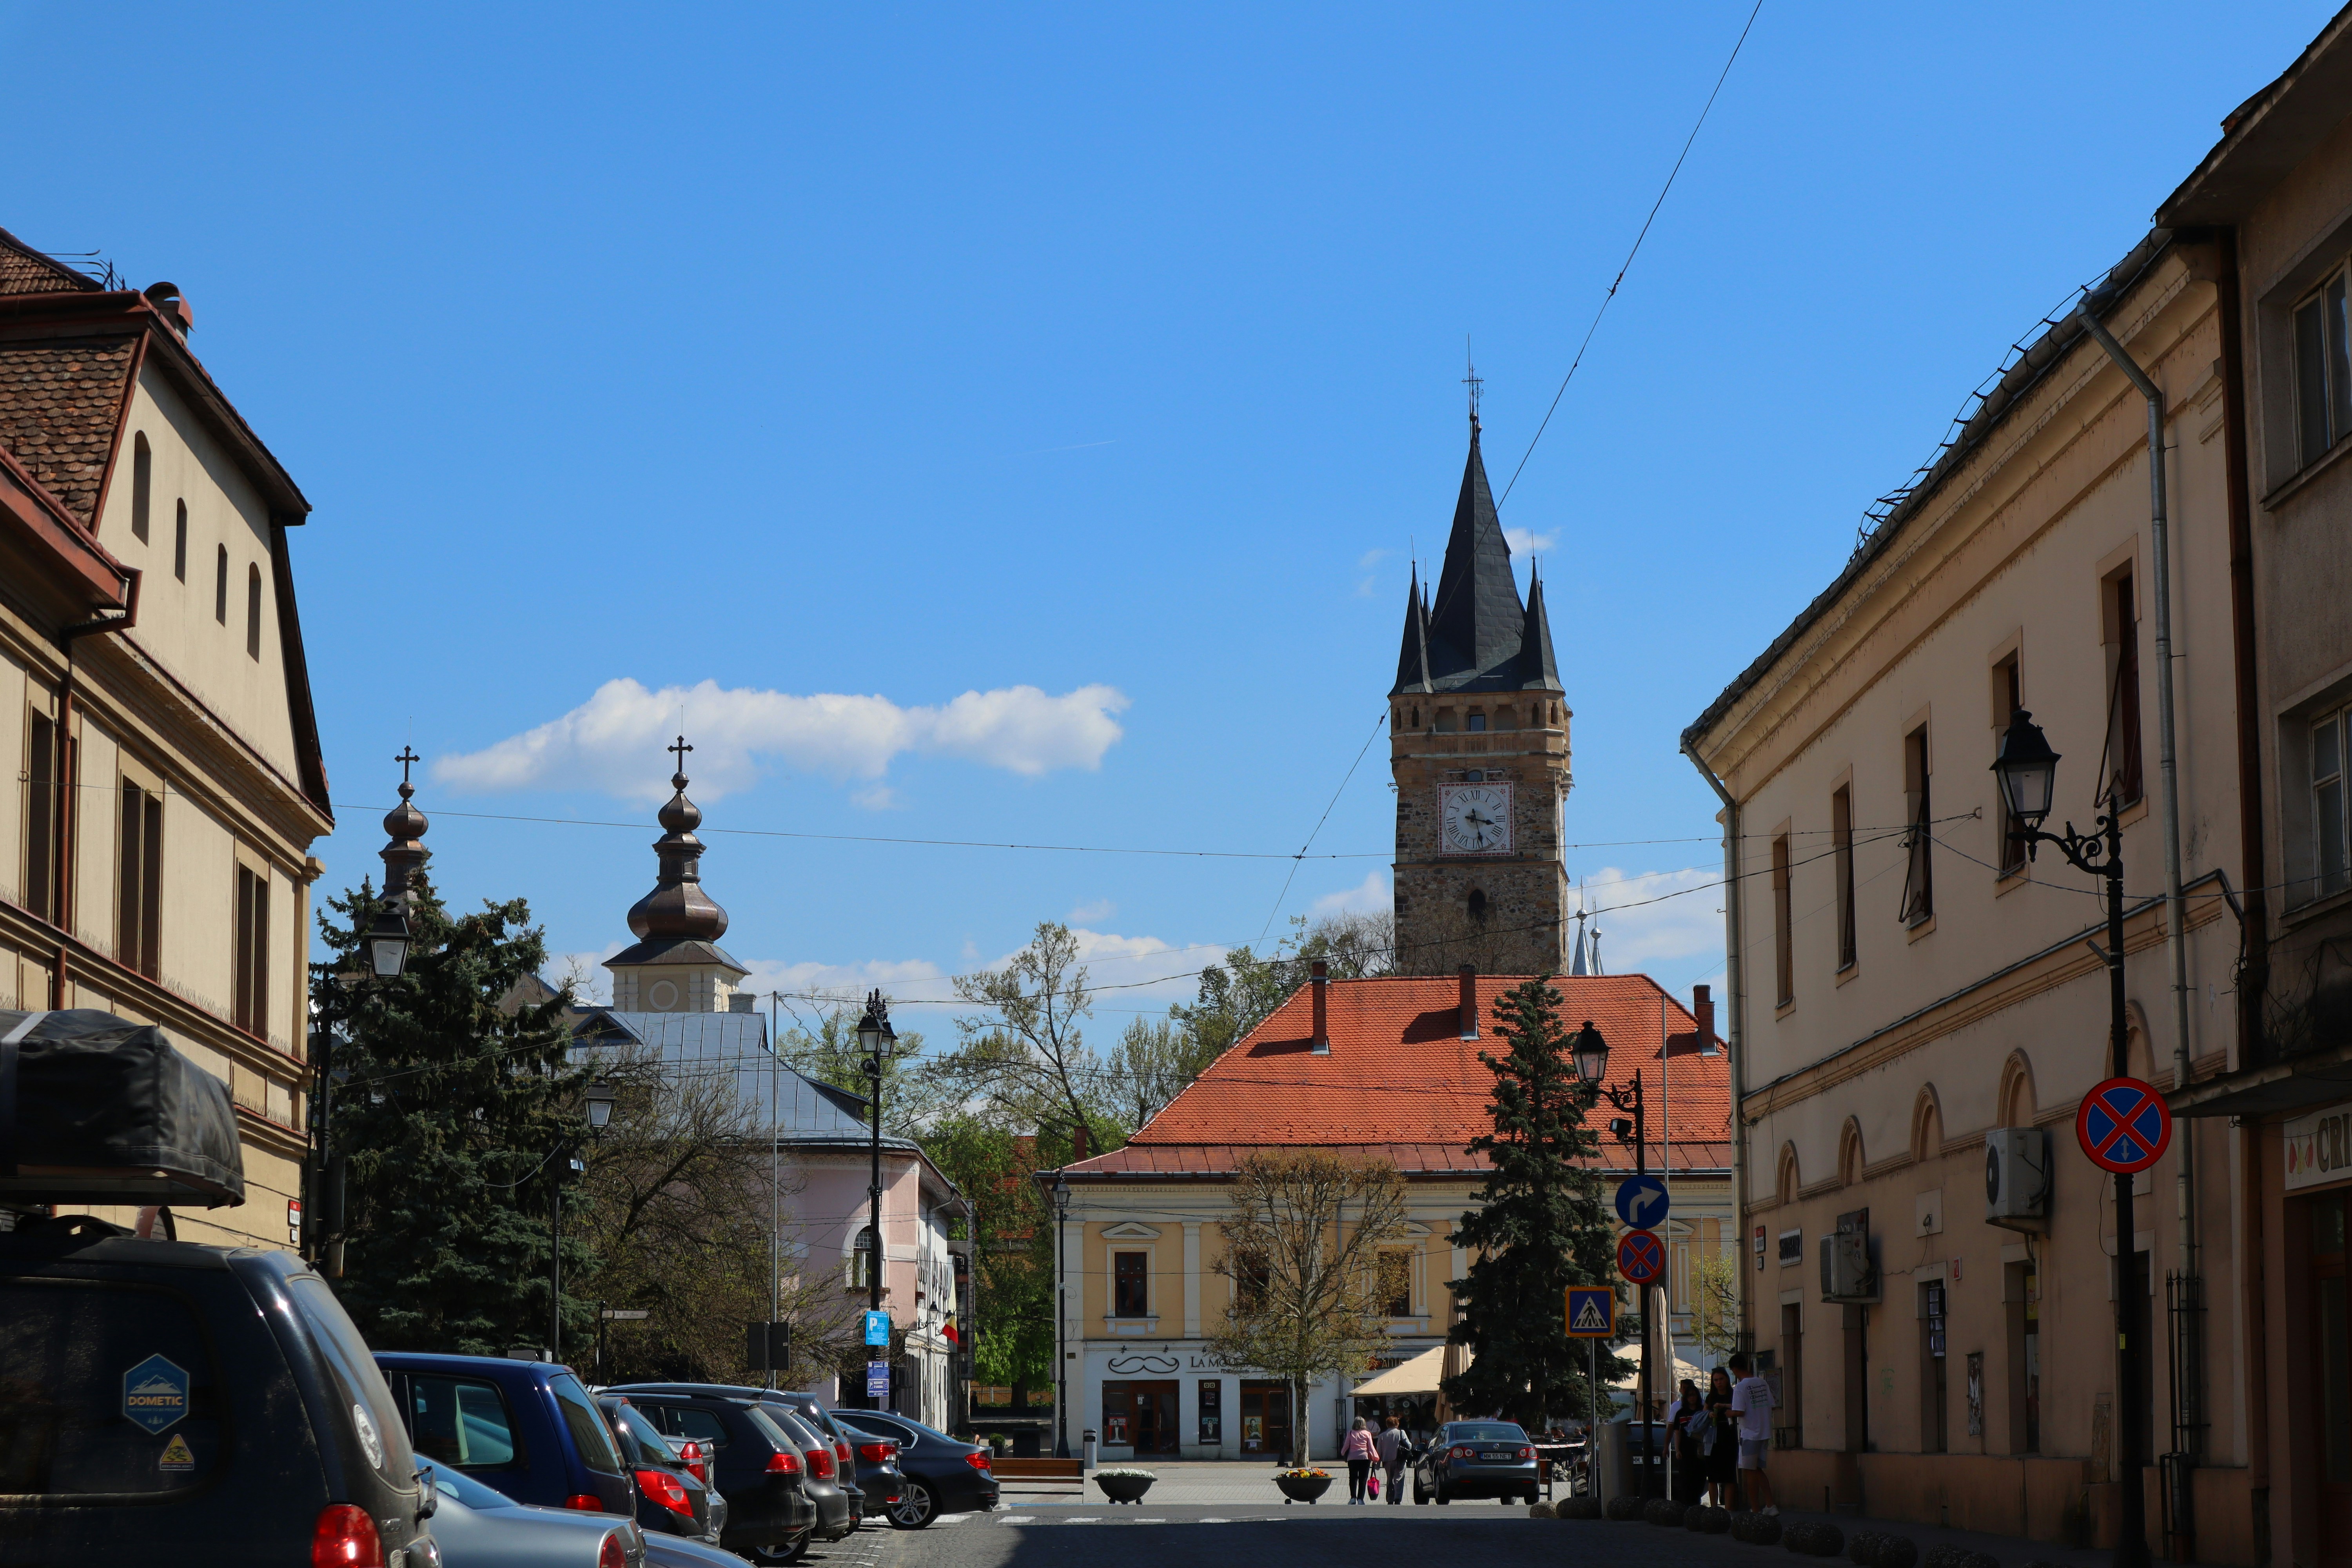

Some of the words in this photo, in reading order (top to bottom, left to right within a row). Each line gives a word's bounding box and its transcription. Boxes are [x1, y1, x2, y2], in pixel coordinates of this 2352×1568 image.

[1458, 793, 1468, 804] XI
[1470, 789, 1480, 800] XII
[1485, 793, 1491, 802] I
[1492, 802, 1502, 811] II
[1448, 825, 1460, 839] VIII
[1458, 834, 1468, 847] VII
[2317, 1112, 2352, 1173] CRI
[869, 1317, 877, 1331] P
[1191, 1356, 1205, 1368] LA
[128, 1396, 183, 1406] DOMETIC
